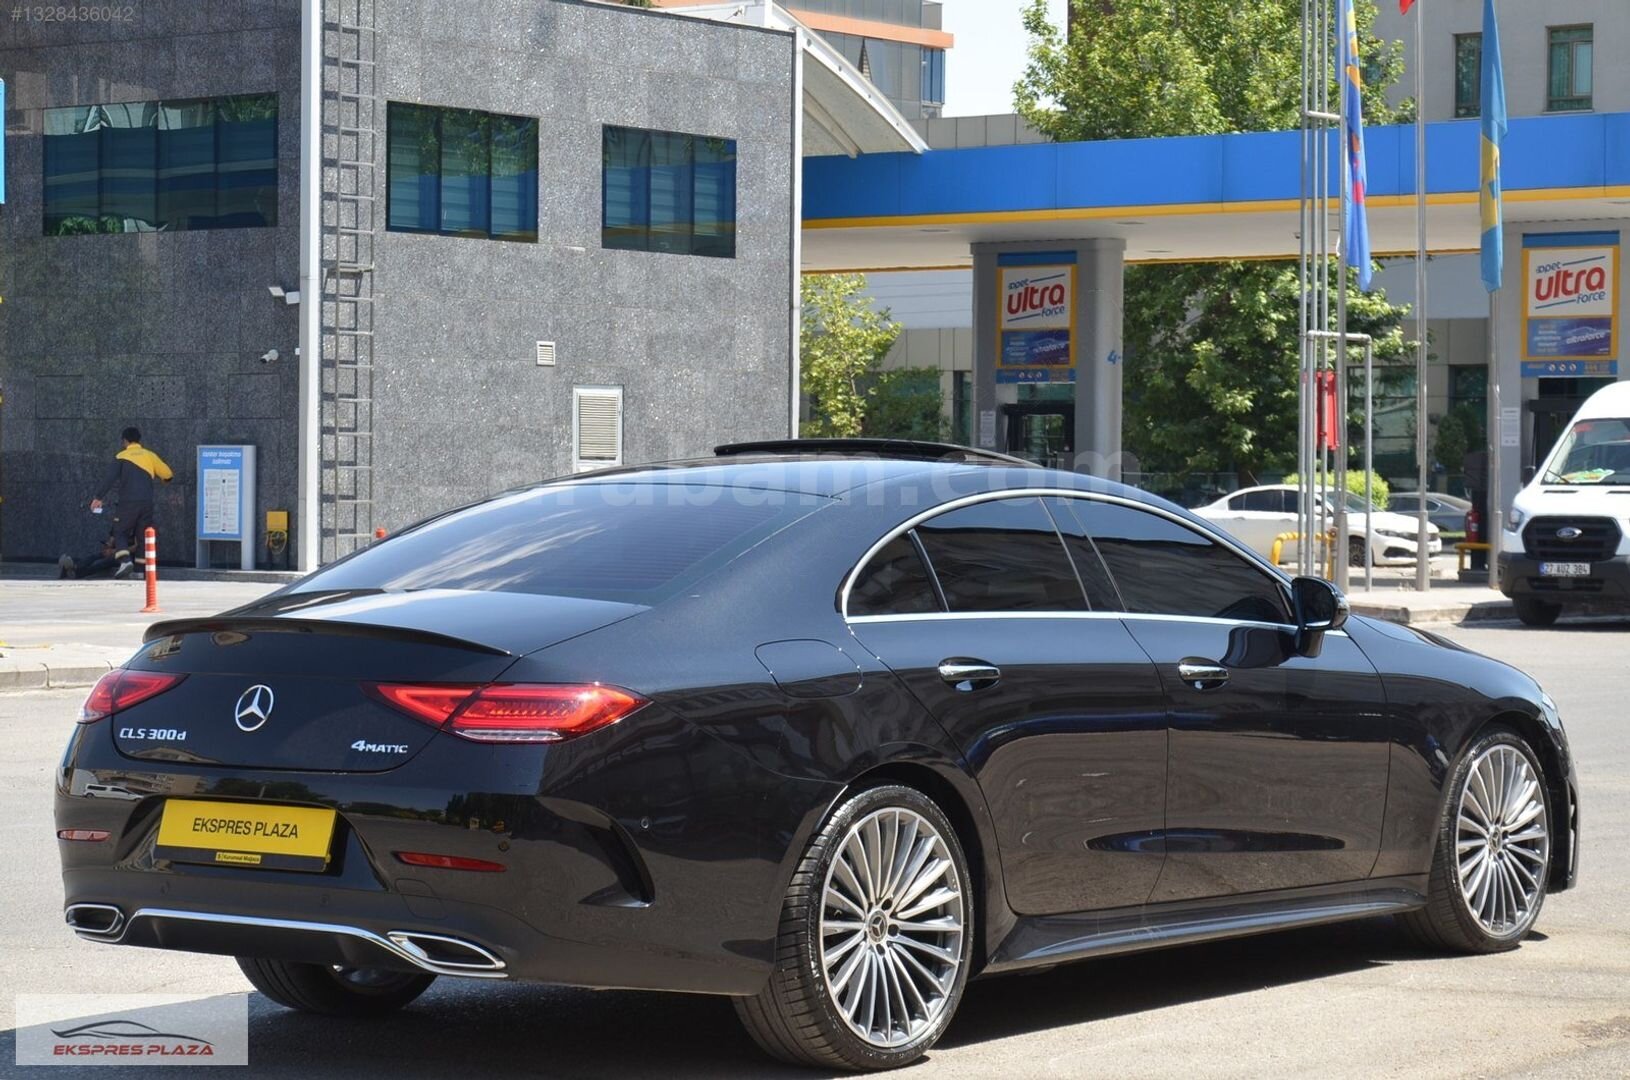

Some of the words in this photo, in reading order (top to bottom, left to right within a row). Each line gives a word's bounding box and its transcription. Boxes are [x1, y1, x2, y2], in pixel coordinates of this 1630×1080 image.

[1535, 266, 1606, 301] ultra
[1007, 284, 1065, 315] ultra
[1576, 290, 1606, 304] force
[1041, 306, 1065, 318] force
[120, 728, 146, 740] CLS
[148, 729, 186, 741] 300d
[351, 740, 409, 754] 4MATIC
[192, 818, 252, 836] EKSPRES
[253, 822, 298, 839] PLAZA
